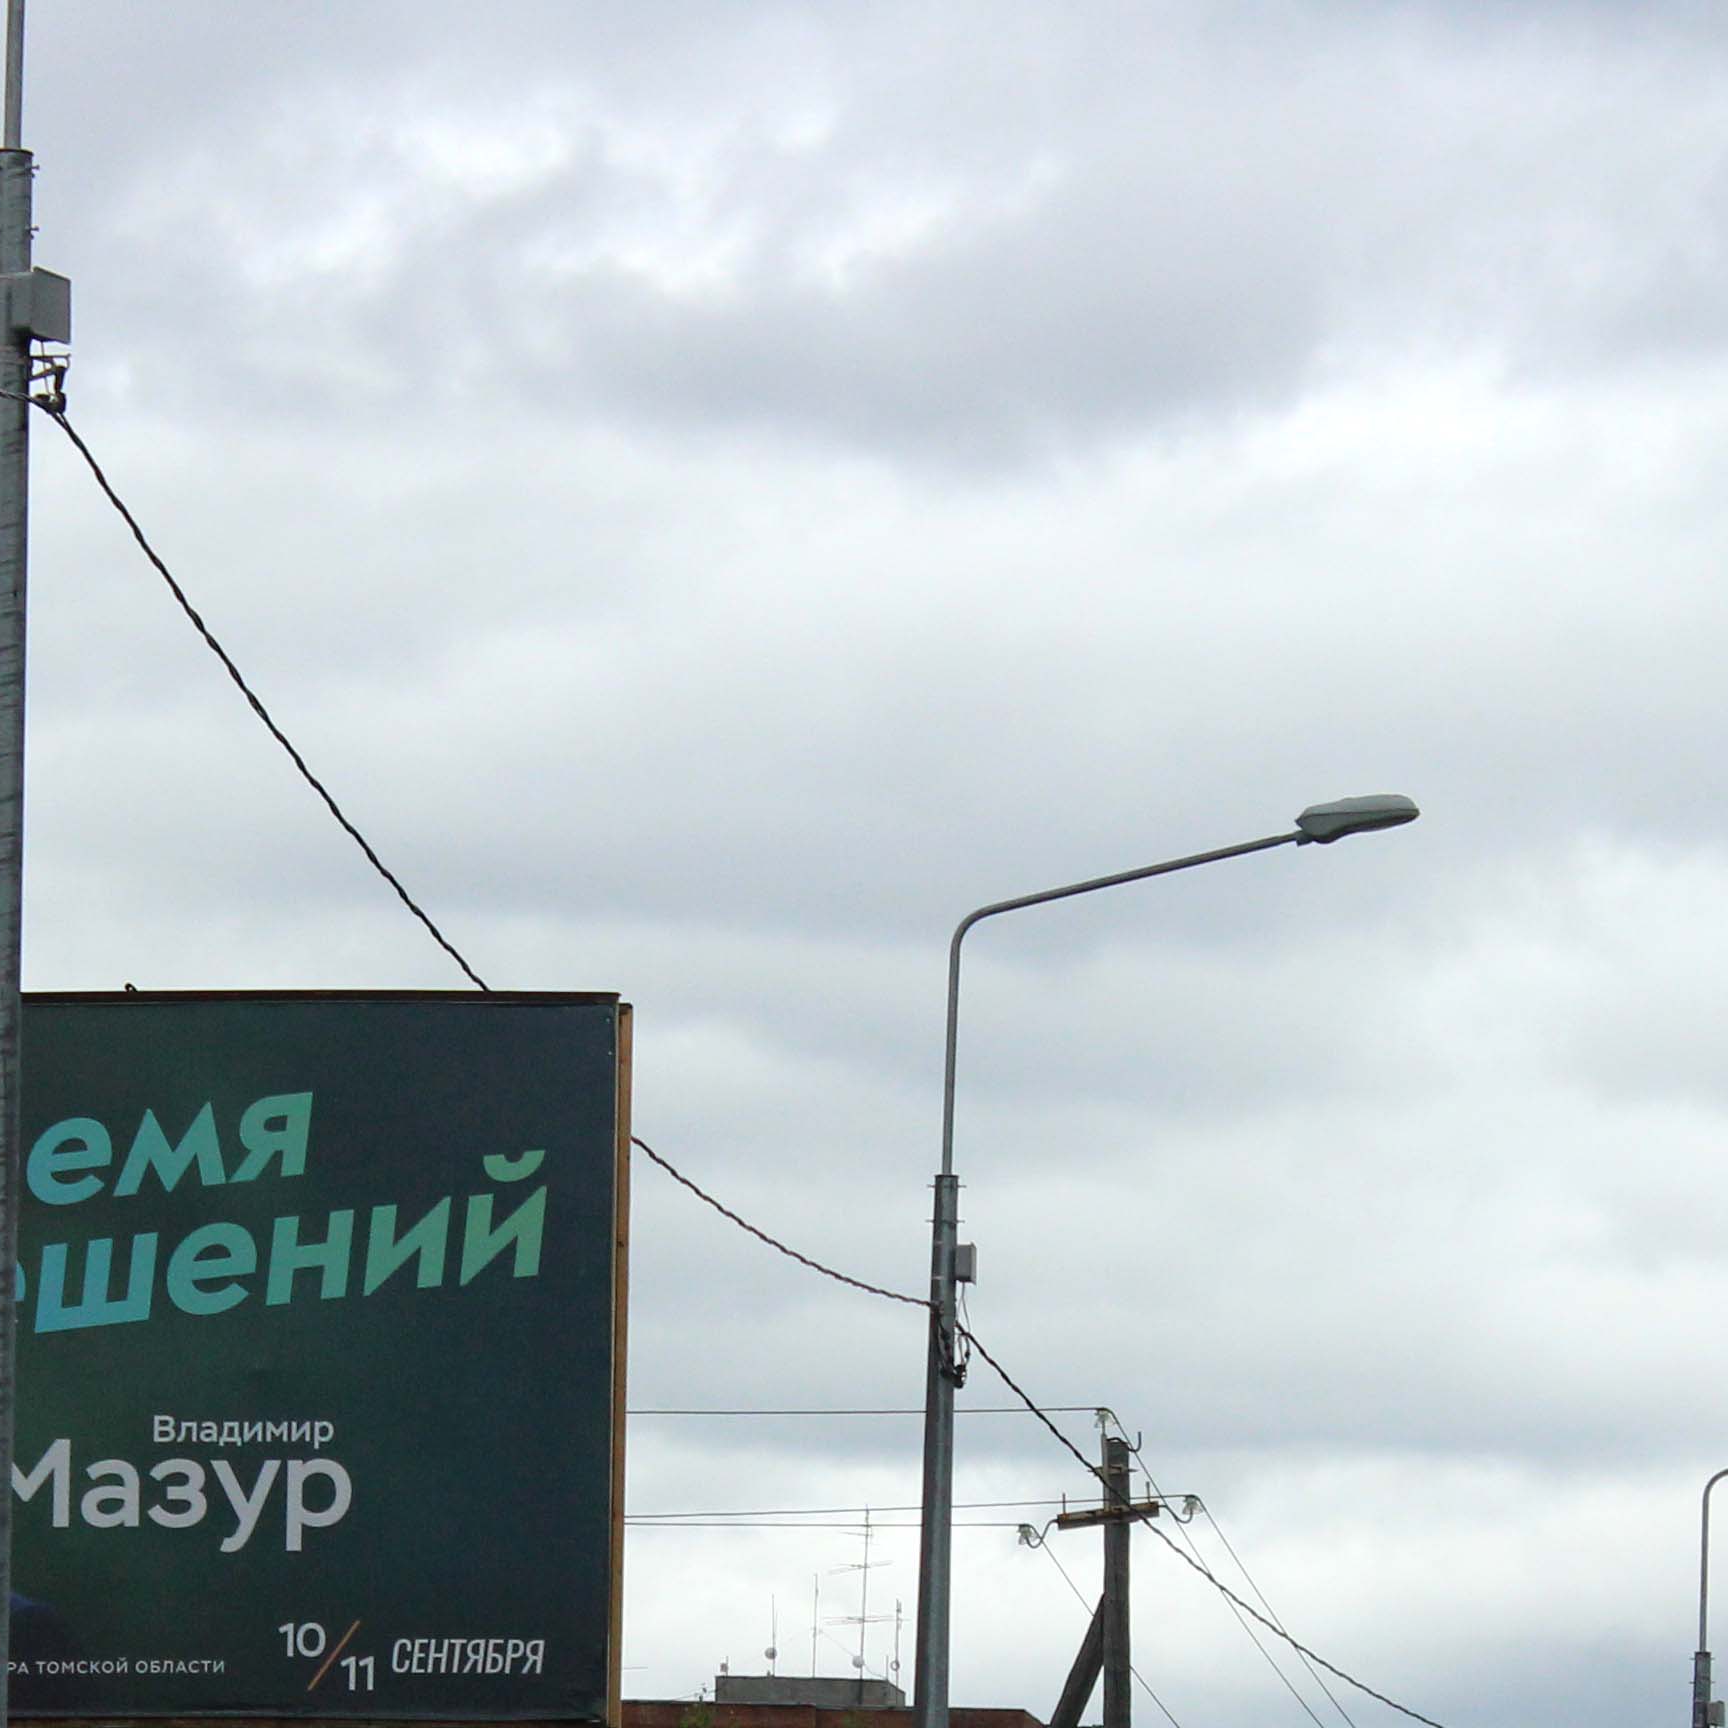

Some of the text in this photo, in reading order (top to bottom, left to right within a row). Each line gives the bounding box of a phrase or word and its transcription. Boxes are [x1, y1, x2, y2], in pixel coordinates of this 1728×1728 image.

[152, 1415, 335, 1448] Владимир
[10, 1438, 353, 1553] Мазур
[36, 1657, 128, 1675] ТОМСКОЙ
[135, 1660, 225, 1674] ОБЛАСТИ
[391, 1638, 546, 1675] СЕНТЯБРЯ
